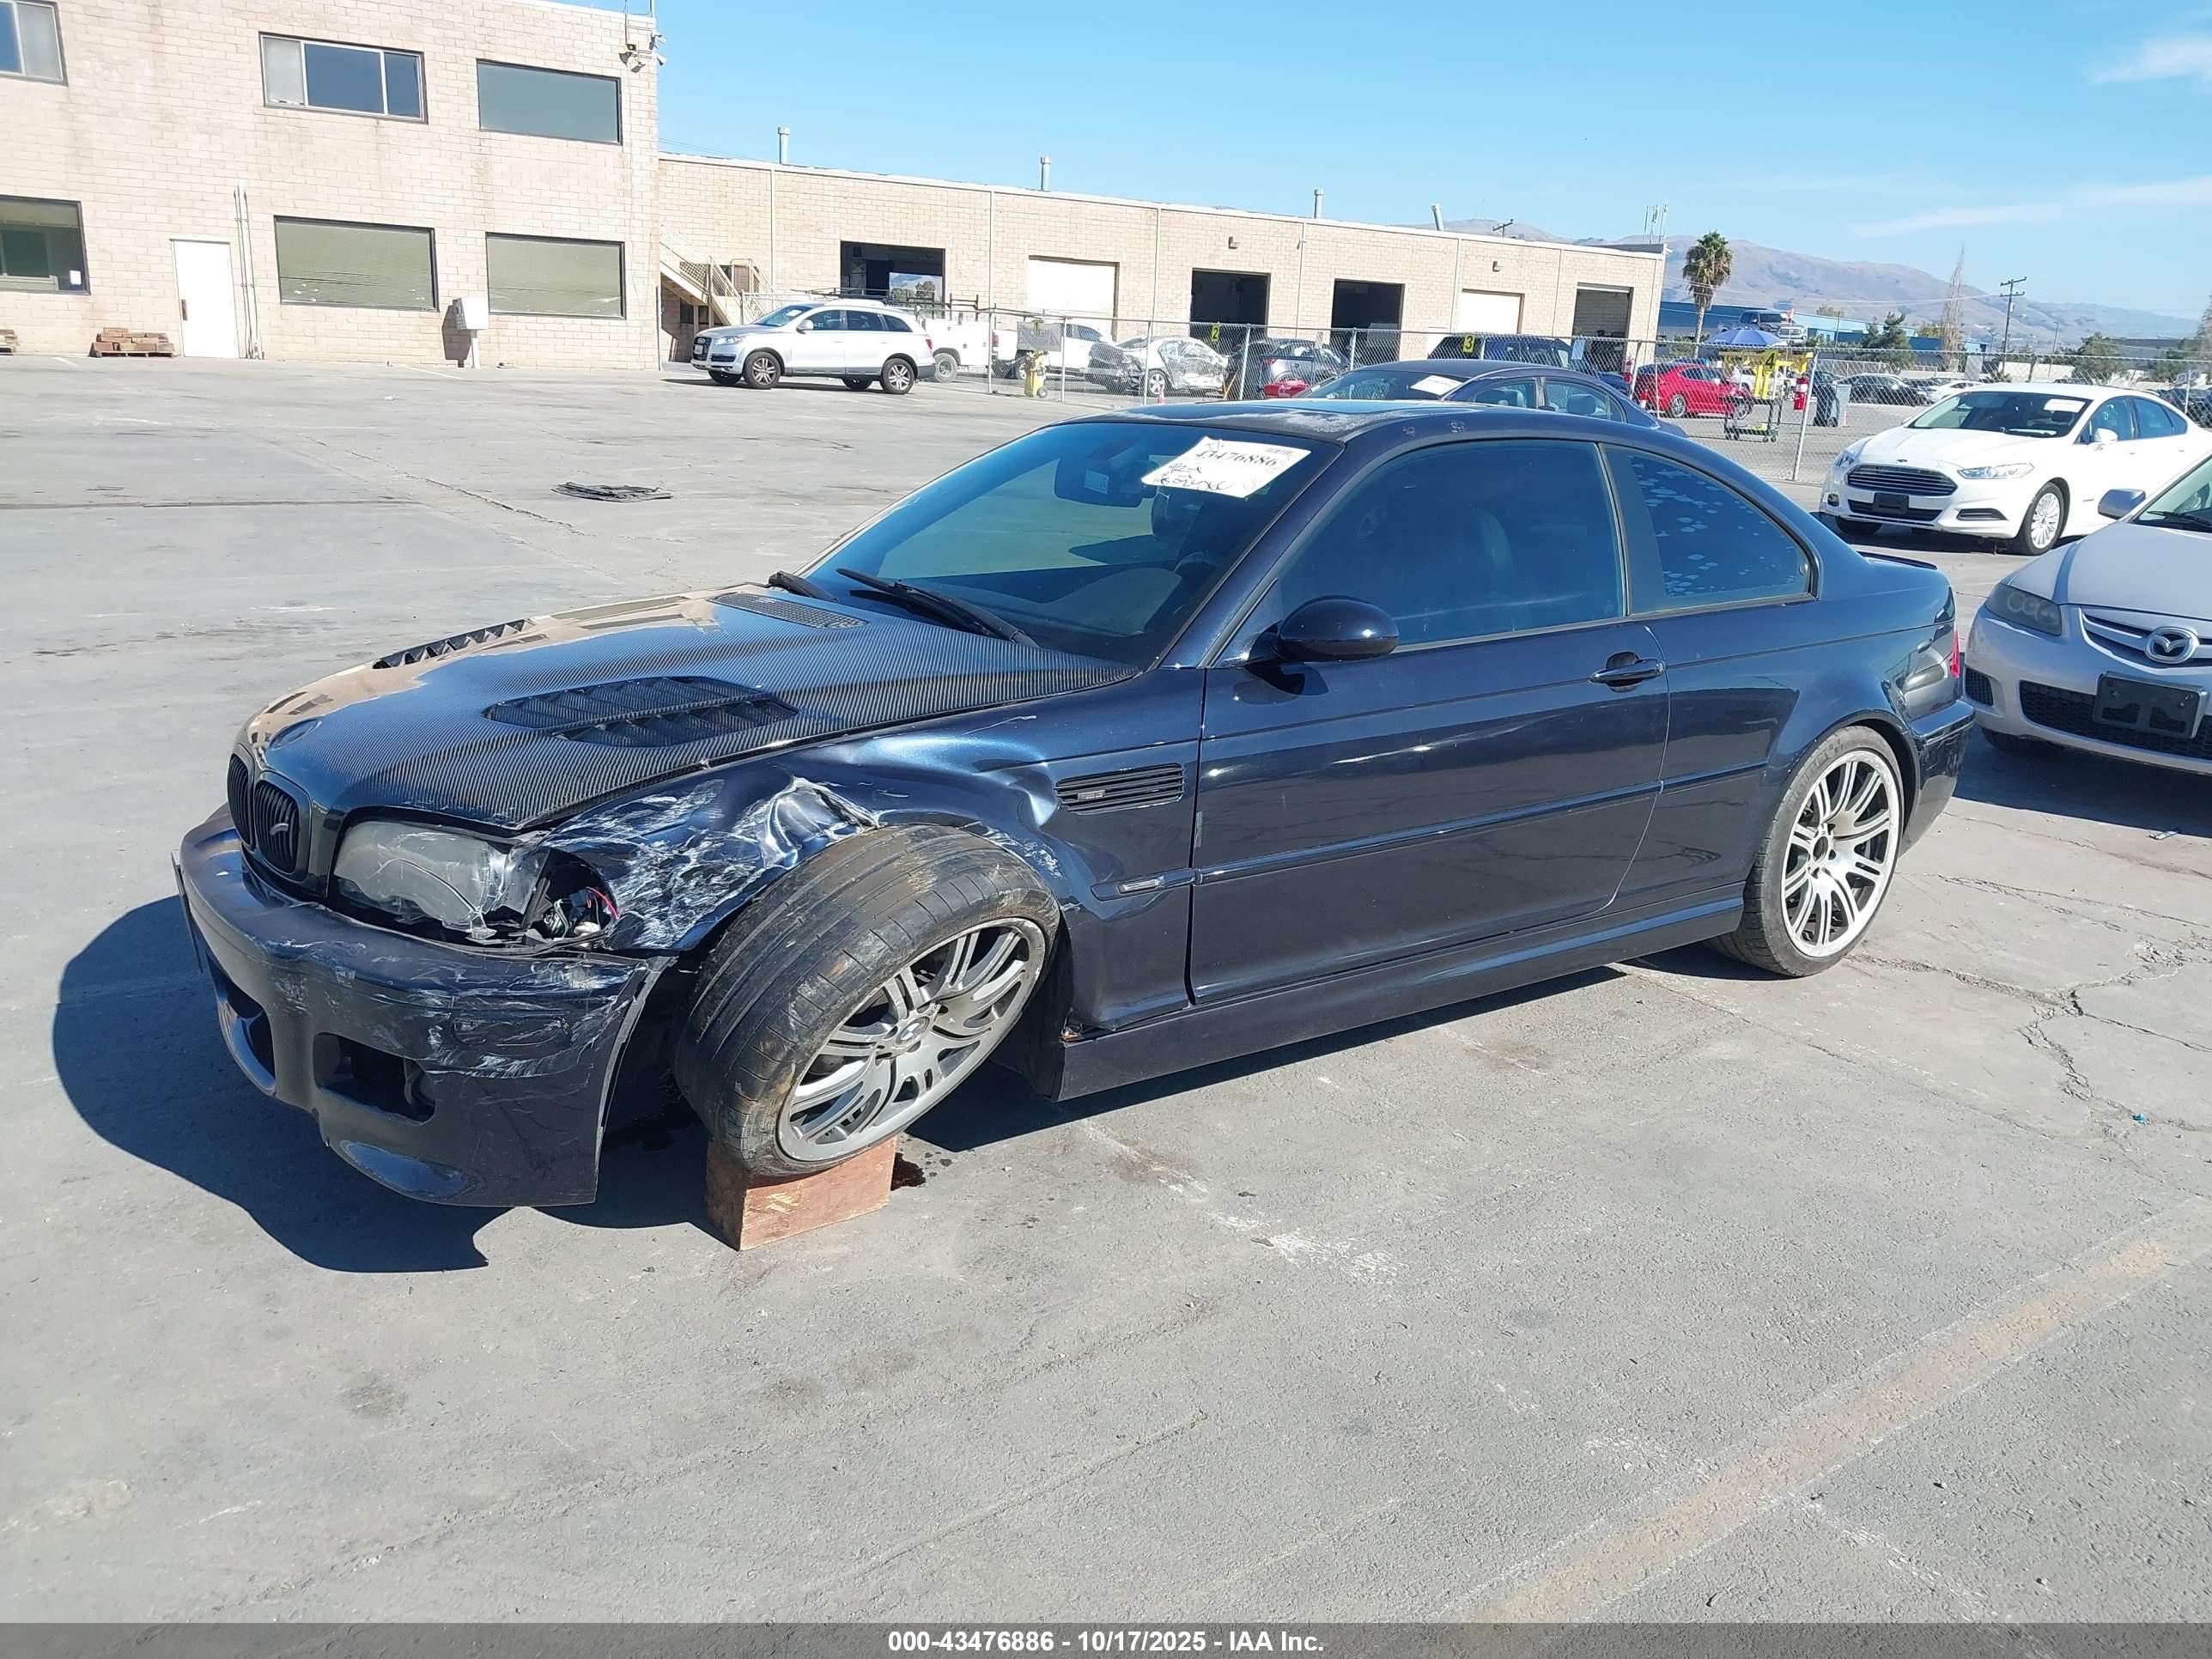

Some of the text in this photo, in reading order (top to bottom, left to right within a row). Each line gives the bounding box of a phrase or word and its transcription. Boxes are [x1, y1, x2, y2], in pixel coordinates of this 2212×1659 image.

[1212, 327, 1218, 339] 2
[1465, 336, 1474, 349] 3
[1765, 352, 1776, 369] 4
